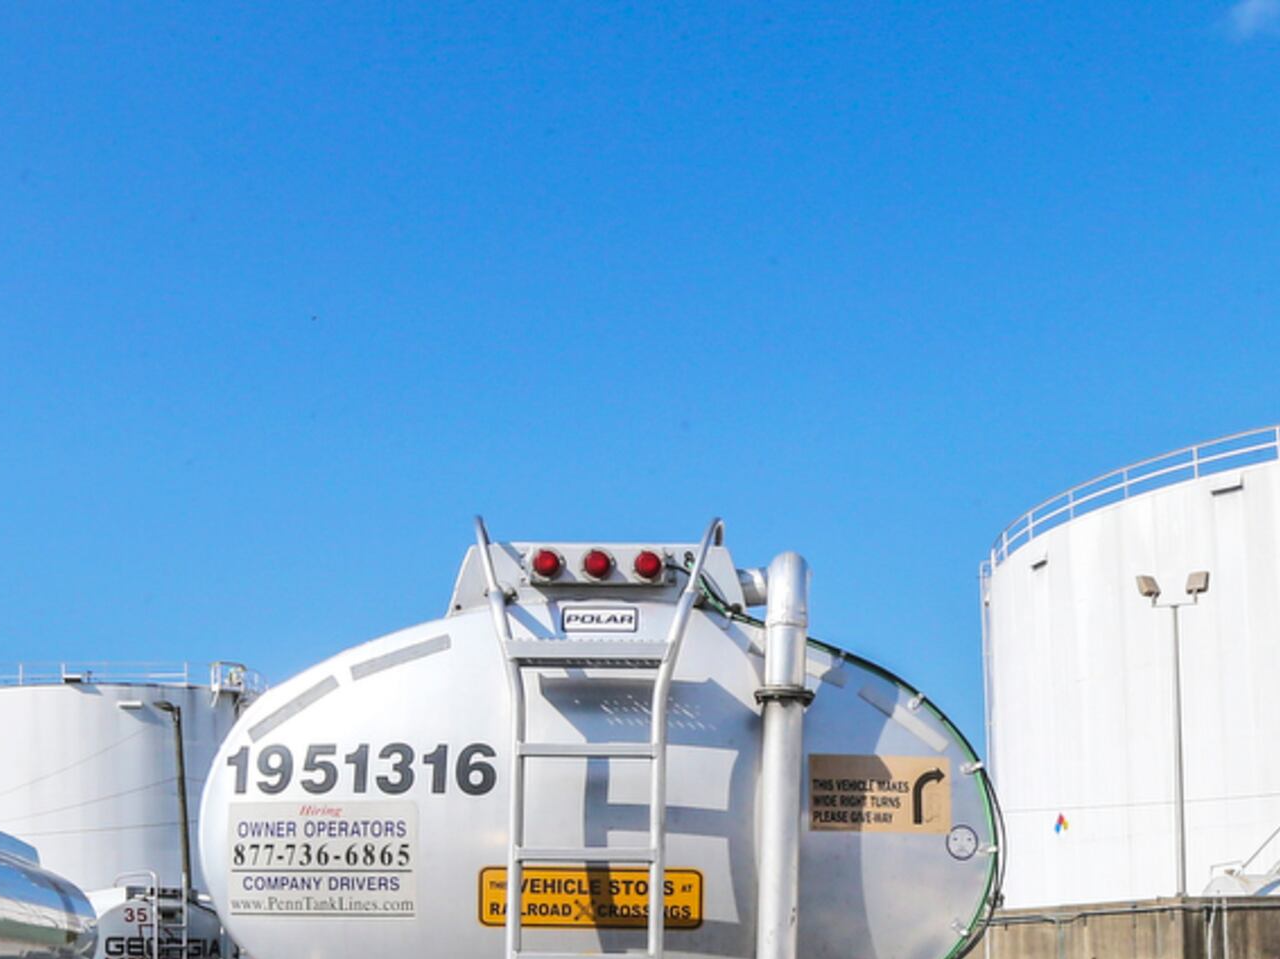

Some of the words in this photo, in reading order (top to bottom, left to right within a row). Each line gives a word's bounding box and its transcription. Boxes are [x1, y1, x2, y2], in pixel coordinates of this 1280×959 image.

[566, 613, 633, 624] POLAR
[227, 743, 497, 795] 1951316
[812, 778, 833, 791] THIS
[836, 778, 874, 791] VEHICLE
[877, 779, 910, 793] MAKES
[812, 795, 837, 807] WIDE
[840, 795, 867, 807] RIGHT
[871, 796, 901, 808] TURNS
[299, 805, 343, 818] Hiring
[813, 811, 848, 823] PLEASE
[851, 811, 870, 823] GIVE
[237, 820, 297, 838] OWNER
[304, 820, 407, 838] OPERATORS
[233, 843, 411, 867] 877-736-6865
[243, 876, 324, 891] COMPANY
[328, 876, 400, 891] DRIVERS
[608, 879, 675, 895] STOS
[231, 896, 414, 912] www.PennTankLines.com
[597, 904, 692, 919] CROSSGS
[124, 907, 148, 922] 35
